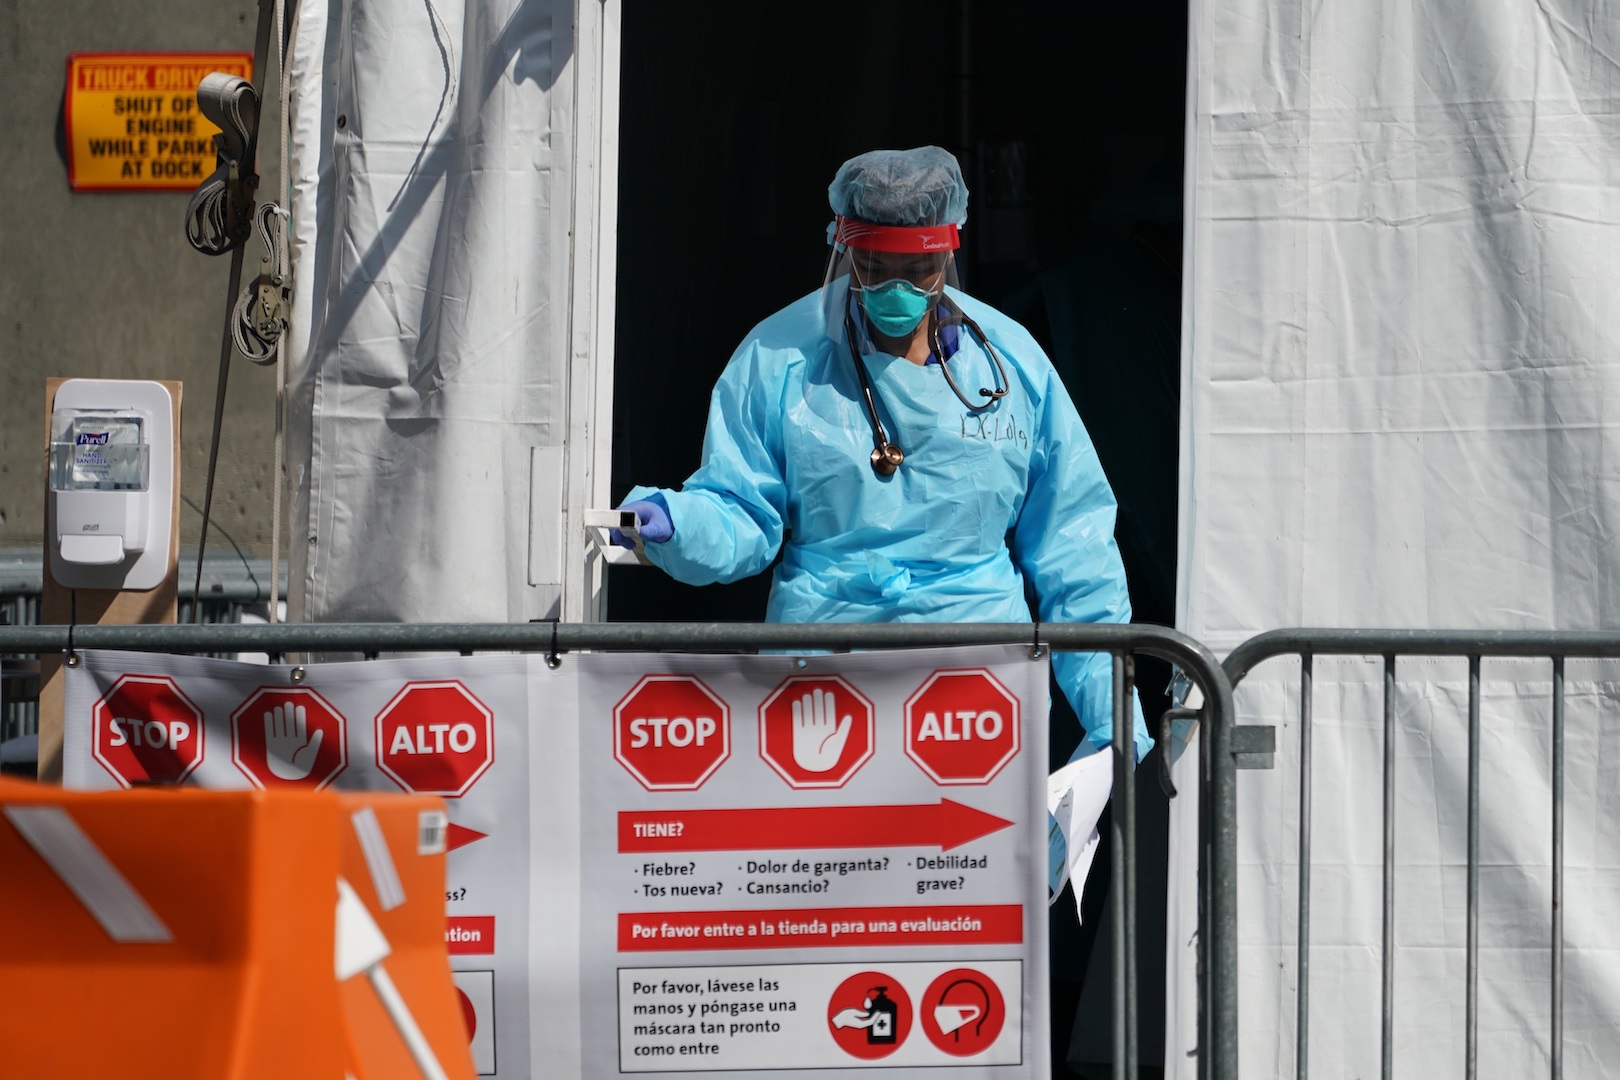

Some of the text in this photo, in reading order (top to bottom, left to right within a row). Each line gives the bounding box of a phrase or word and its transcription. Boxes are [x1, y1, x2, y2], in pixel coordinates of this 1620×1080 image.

[81, 67, 148, 89] TRUCK
[114, 97, 164, 114] SHUT
[127, 118, 196, 135] ENGINE
[89, 139, 148, 157] WHILE
[122, 161, 203, 178] AT DOCK
[110, 719, 189, 749] STOP
[630, 718, 716, 747] STOP
[918, 711, 1002, 741] ALTO
[390, 723, 476, 754] ALTO
[634, 822, 684, 837] TIENE?
[644, 862, 695, 876] Fiebre?
[747, 857, 889, 876] Dolor de garganta?
[917, 855, 987, 869] Debilidad
[643, 882, 722, 896] Tos nueva?
[747, 880, 829, 894] Cansancio?
[917, 877, 964, 894] grave?
[633, 917, 981, 938] Por favor entre a la tienda para una evaluación
[633, 978, 779, 995] Por favor, lávese las
[634, 1000, 796, 1017] manos y póngase una
[634, 1020, 780, 1037] máscara tan pronto
[634, 1043, 719, 1056] como entre
